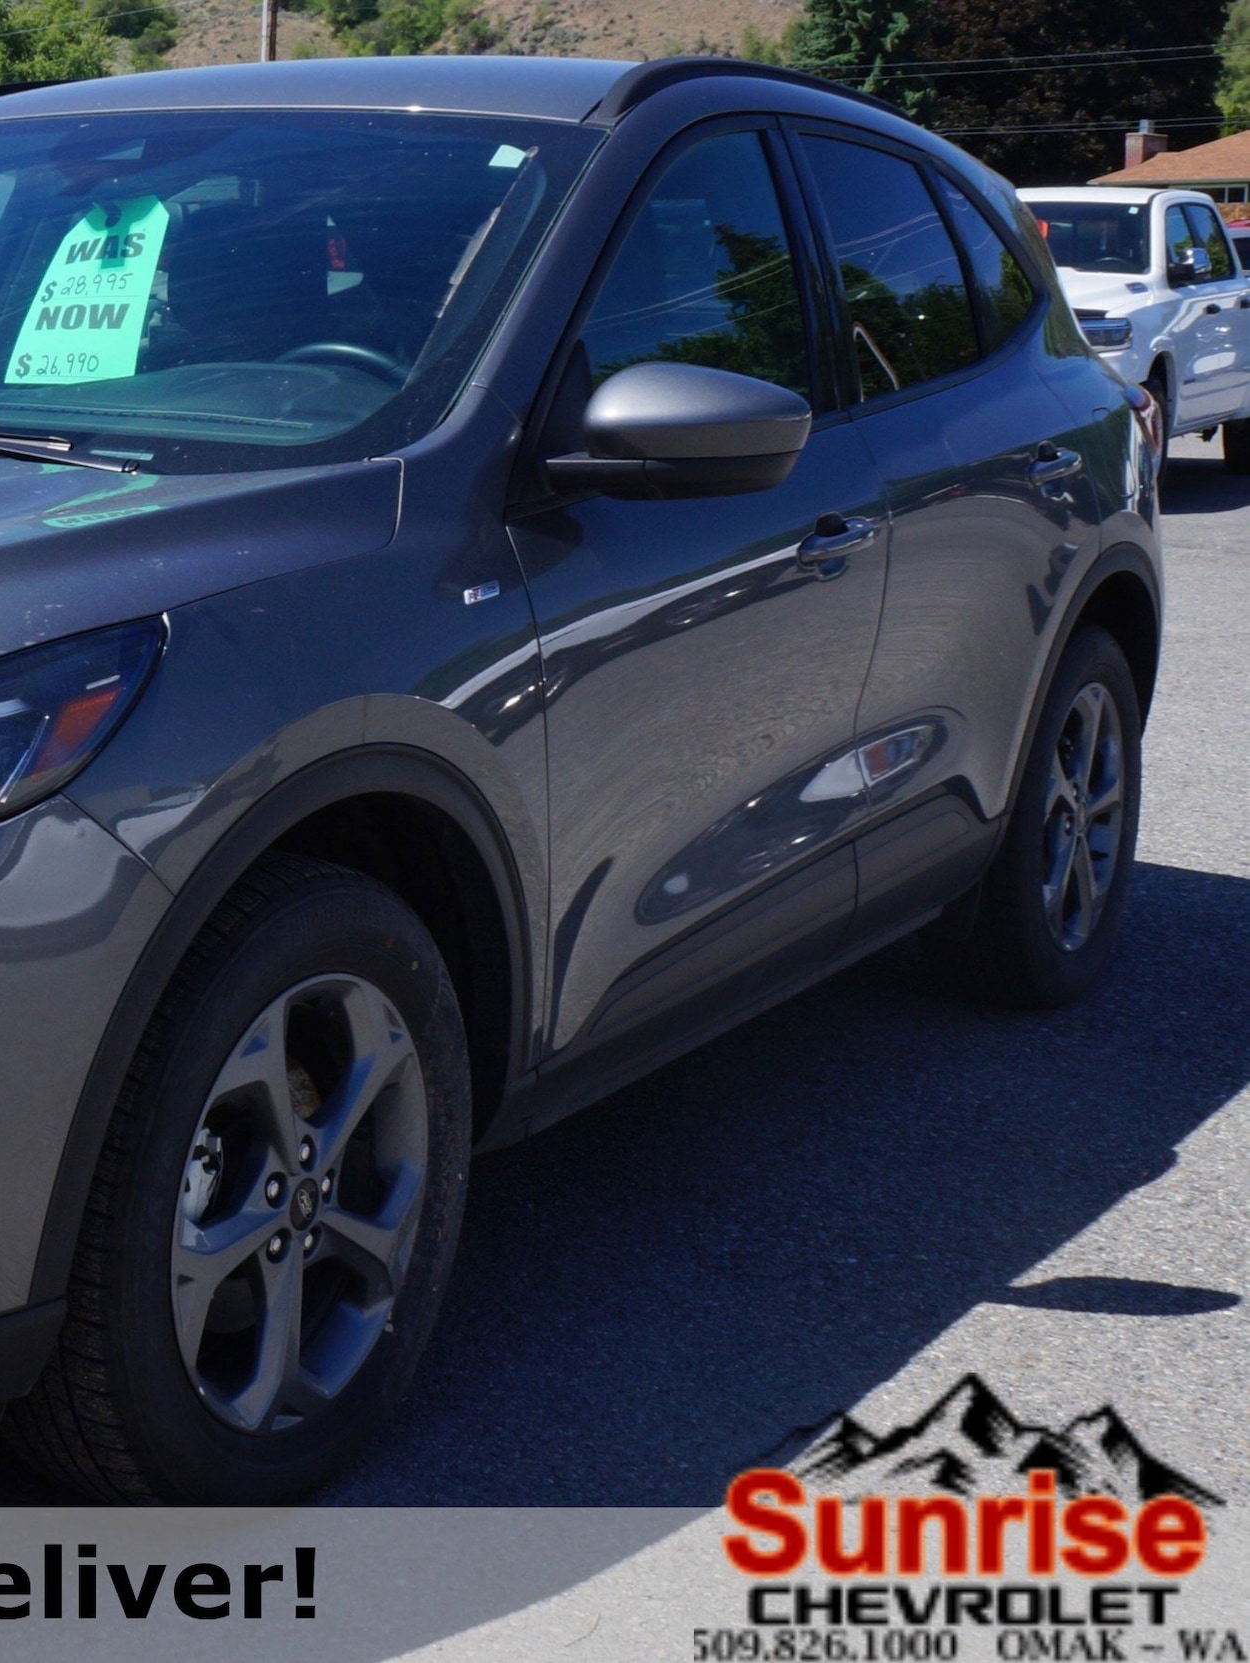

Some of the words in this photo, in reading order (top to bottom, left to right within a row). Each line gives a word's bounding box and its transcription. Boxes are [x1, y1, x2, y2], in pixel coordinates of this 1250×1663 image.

[65, 233, 146, 265] WAS
[60, 273, 134, 296] 28,995
[35, 303, 130, 331] NOW
[36, 352, 100, 376] 26,990
